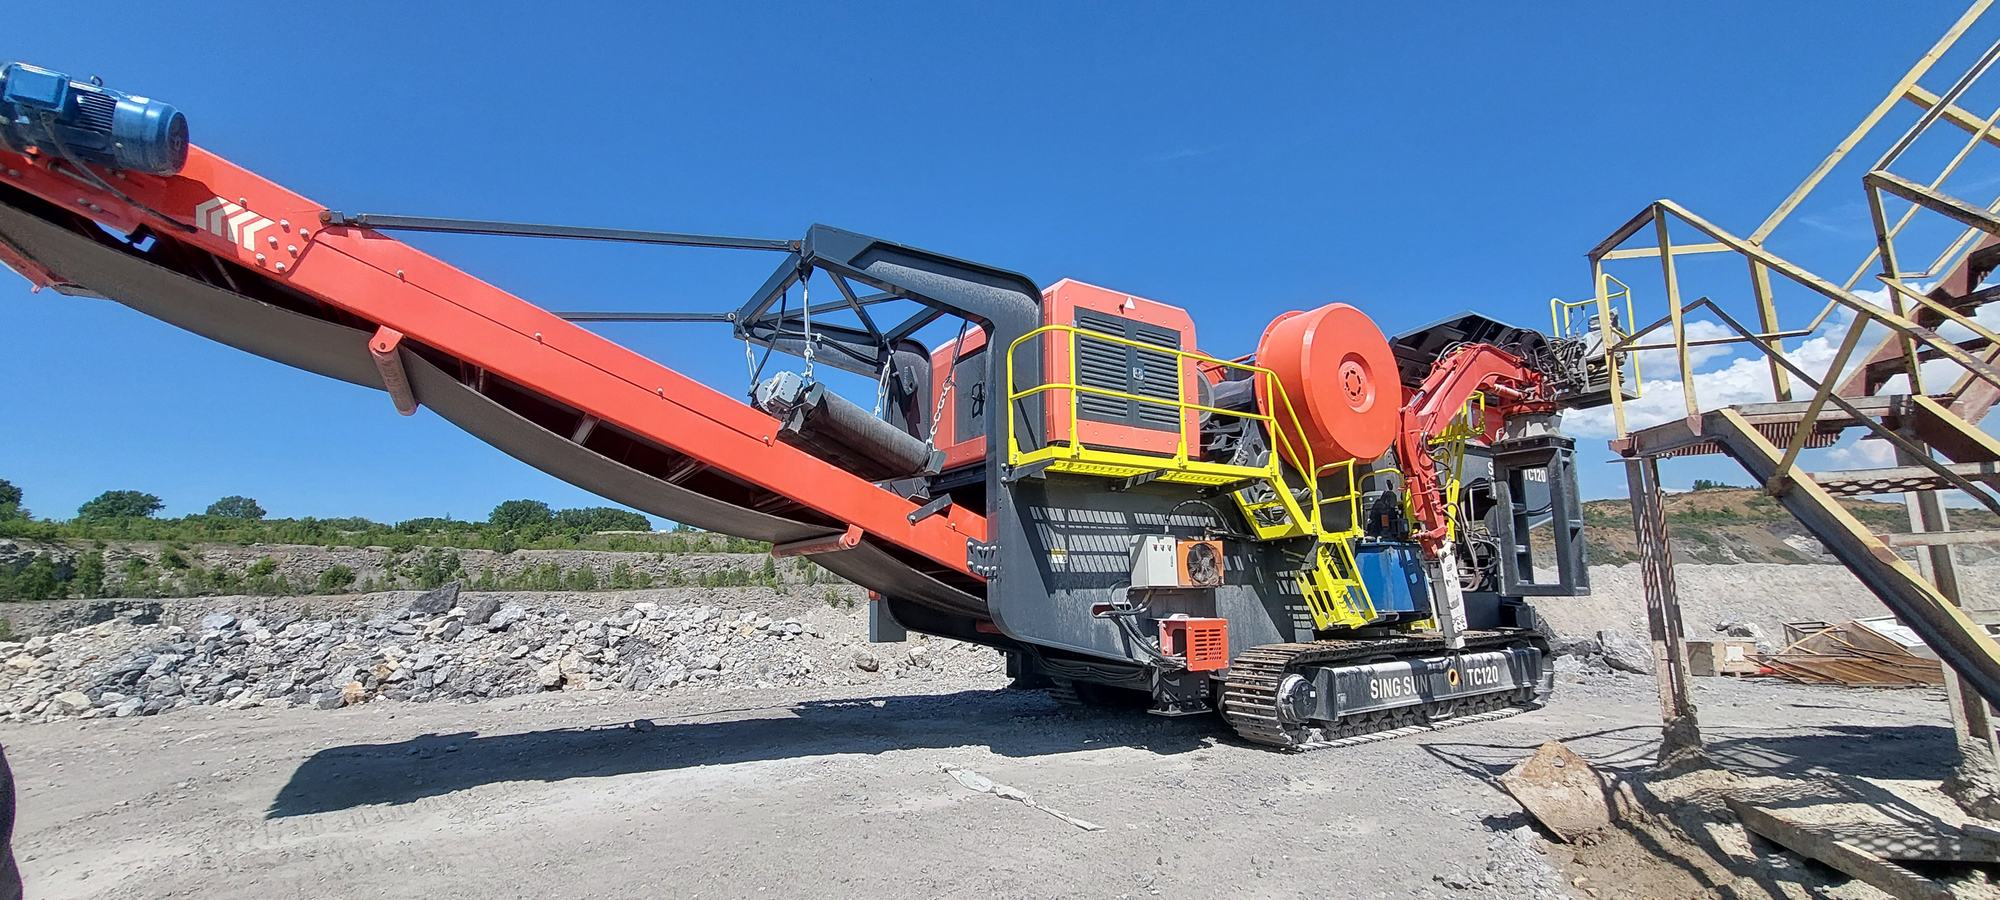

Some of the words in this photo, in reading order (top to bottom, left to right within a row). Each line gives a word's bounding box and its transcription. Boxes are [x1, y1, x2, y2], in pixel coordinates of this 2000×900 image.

[1370, 676, 1401, 699] SING
[1403, 674, 1428, 696] SUN
[1467, 666, 1498, 686] TC120
